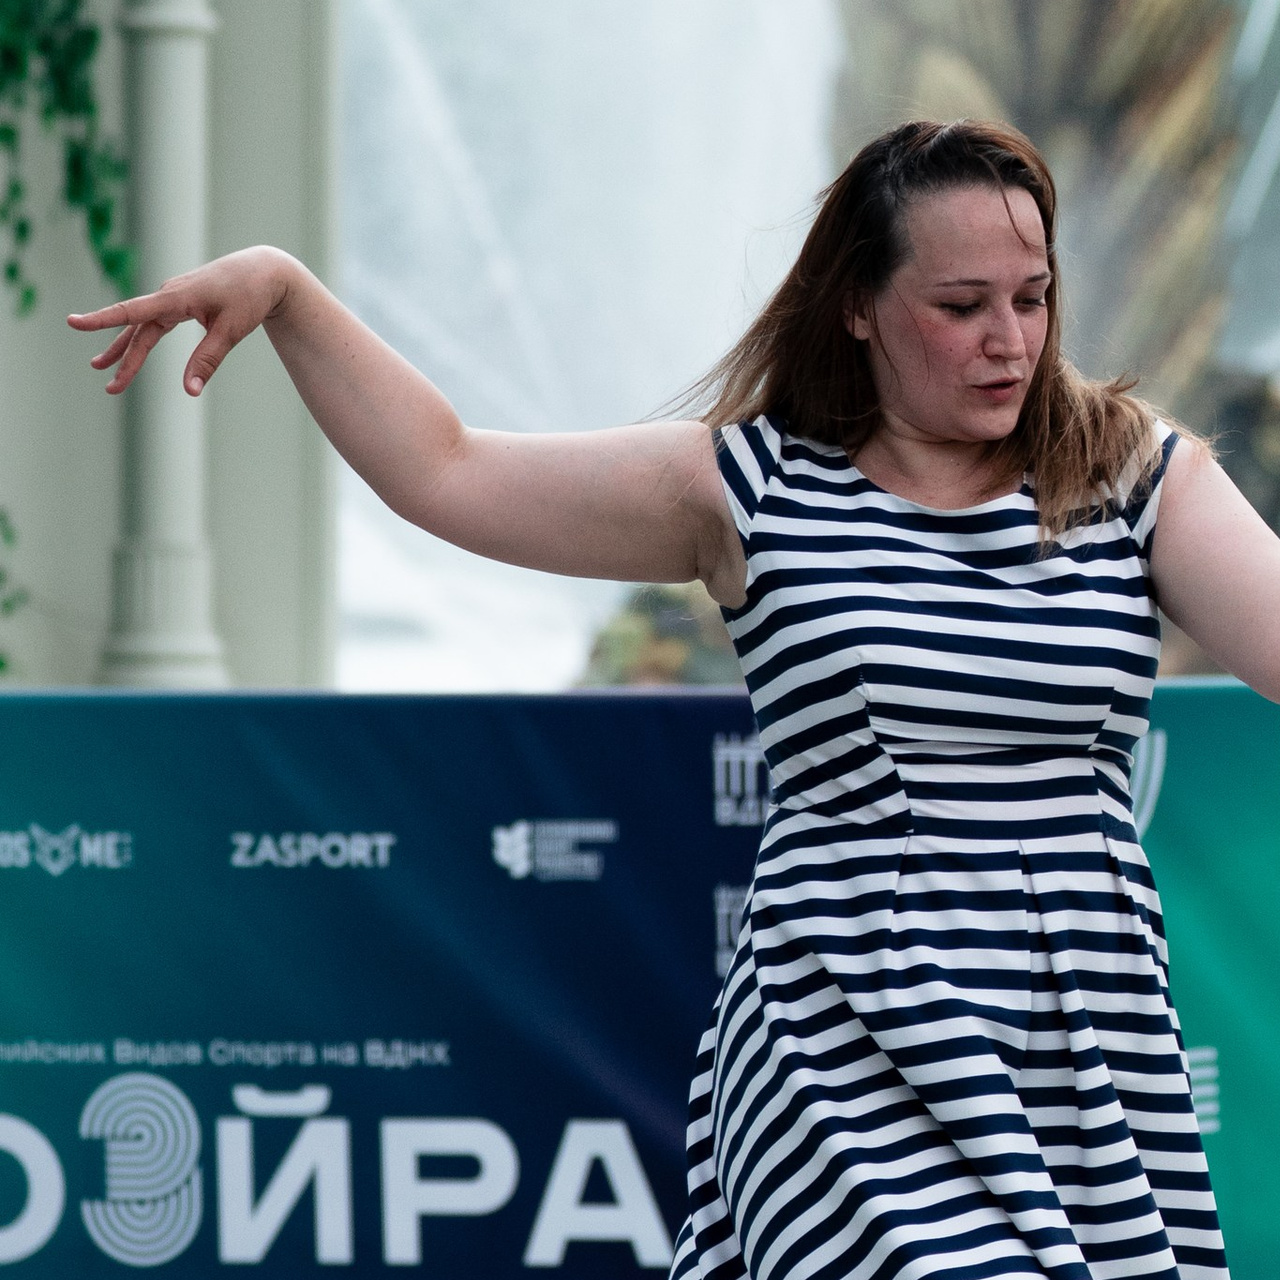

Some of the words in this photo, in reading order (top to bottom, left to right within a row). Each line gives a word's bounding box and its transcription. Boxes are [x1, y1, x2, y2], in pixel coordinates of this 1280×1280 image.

[231, 832, 395, 867] ZASPORT
[113, 1038, 202, 1065] Видов
[208, 1038, 315, 1068] Спорта
[322, 1042, 358, 1063] на
[364, 1038, 447, 1068] ВДНХ
